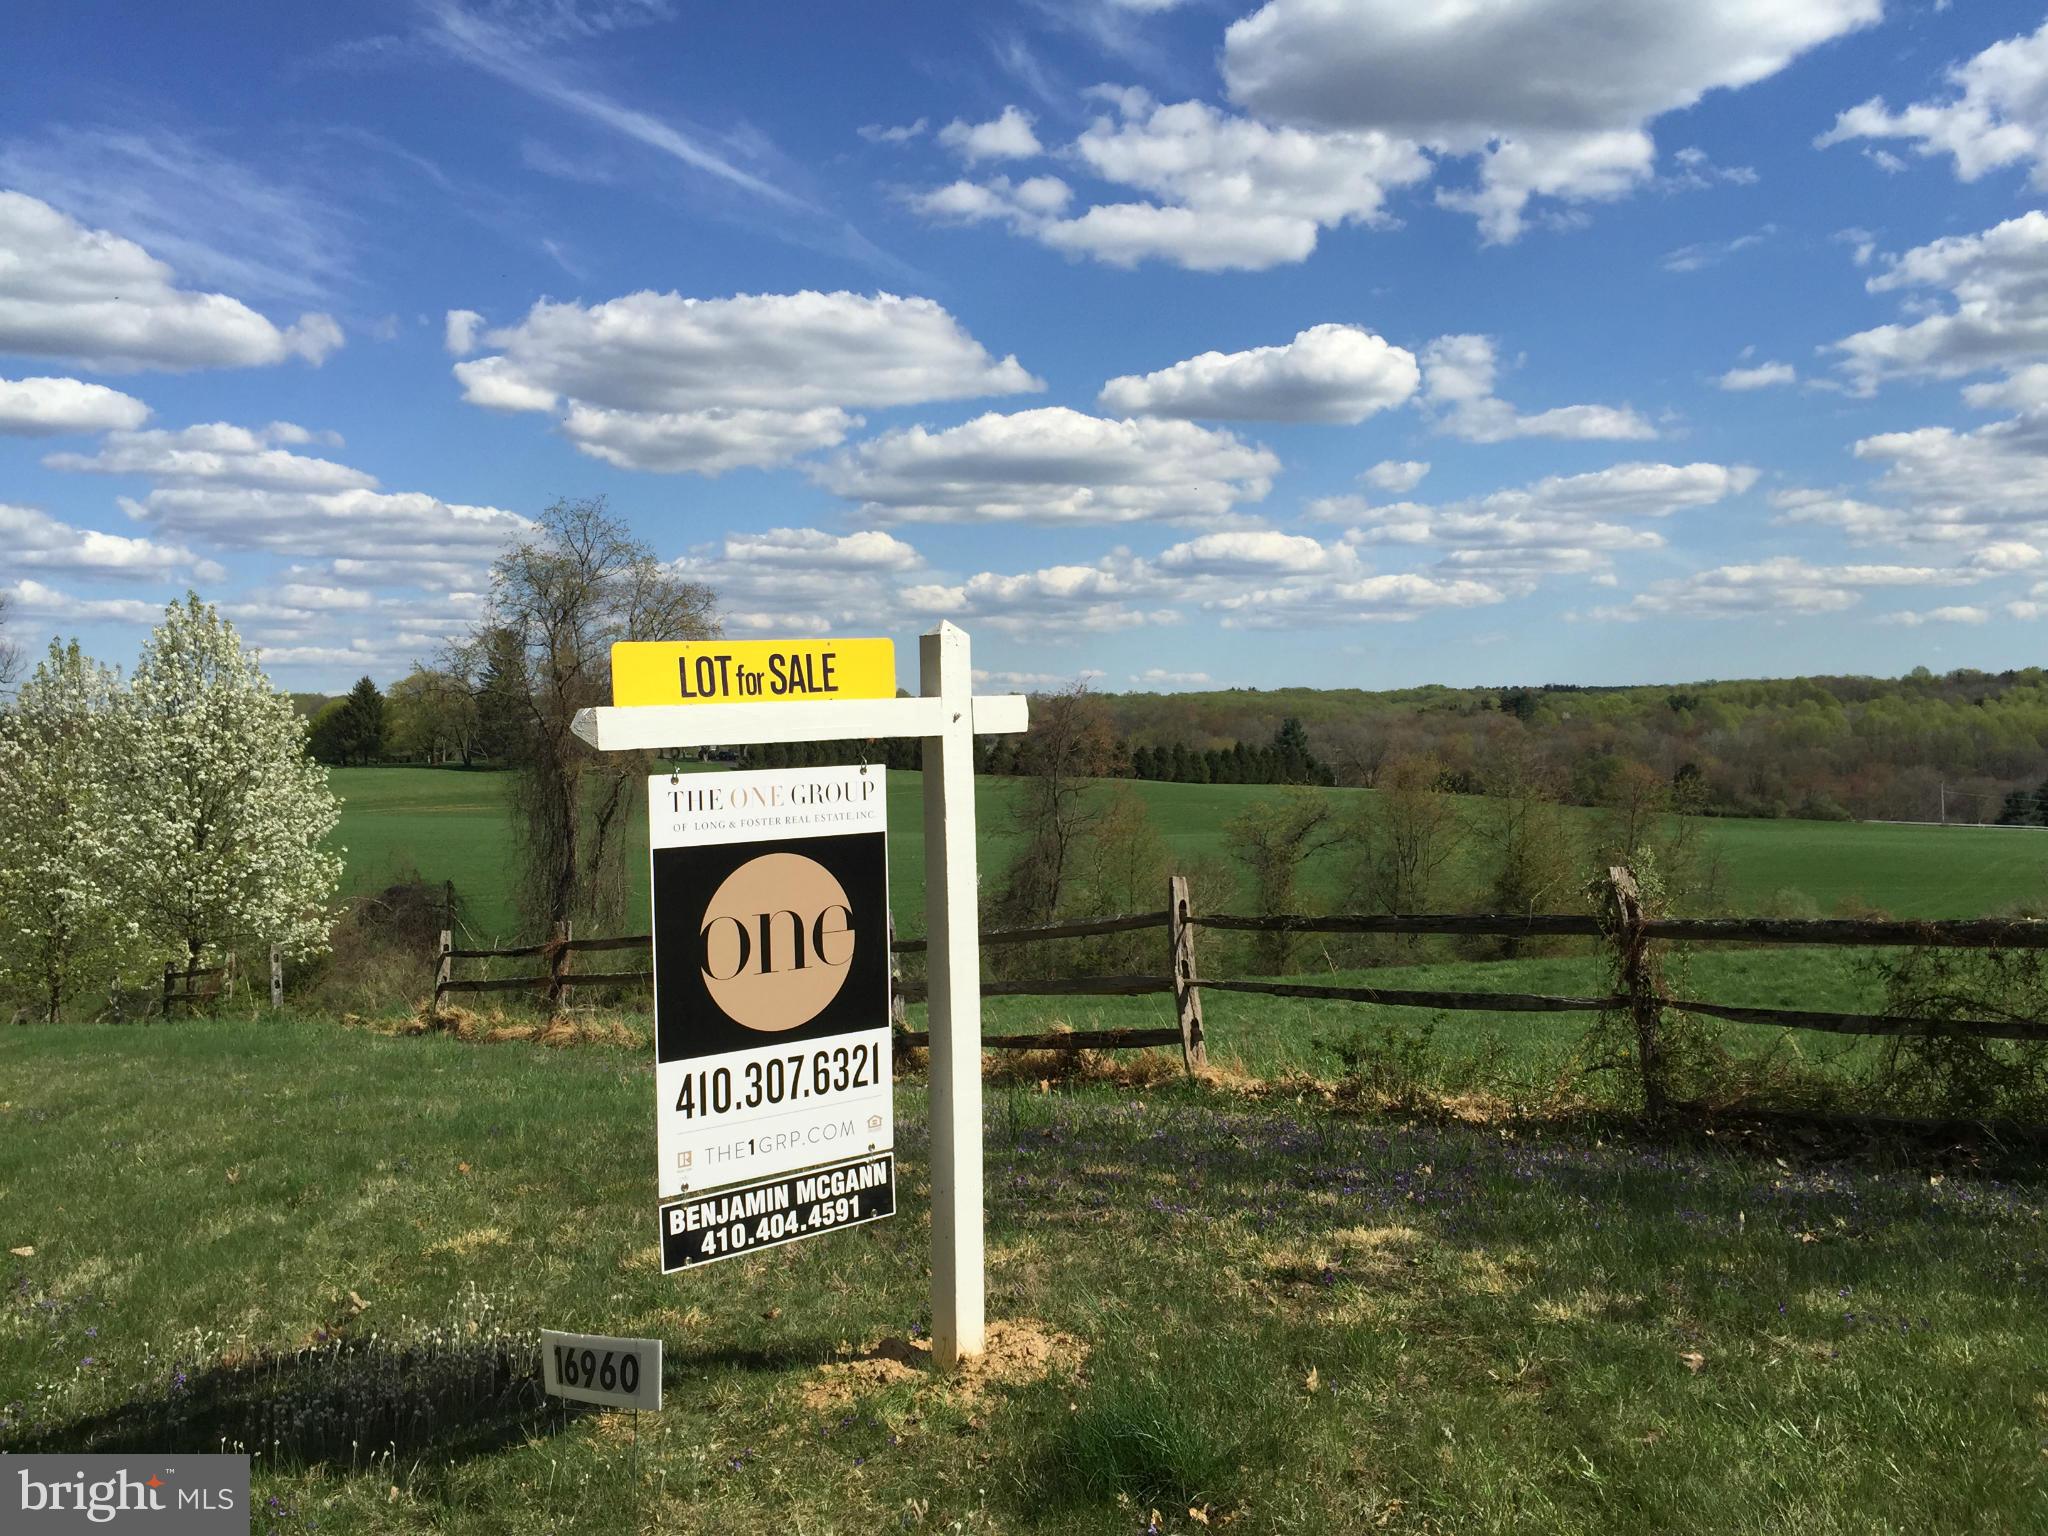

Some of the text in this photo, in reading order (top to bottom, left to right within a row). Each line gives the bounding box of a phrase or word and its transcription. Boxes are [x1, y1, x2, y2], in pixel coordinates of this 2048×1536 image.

[679, 653, 839, 699] LOT for SALE
[667, 780, 875, 812] THE ONE GROUP
[673, 823, 688, 833] OF
[694, 821, 726, 831] LONG
[728, 821, 736, 829] &
[740, 816, 781, 828] FOSTER
[785, 815, 811, 825] REAL
[700, 904, 856, 981] one
[675, 1042, 879, 1119] 410.307.6321
[705, 1120, 856, 1165] THE1GRP.COM
[669, 1161, 888, 1236] BENJAMIN MCGANN
[701, 1194, 860, 1255] 410.404.4591
[554, 1346, 639, 1393] 16960
